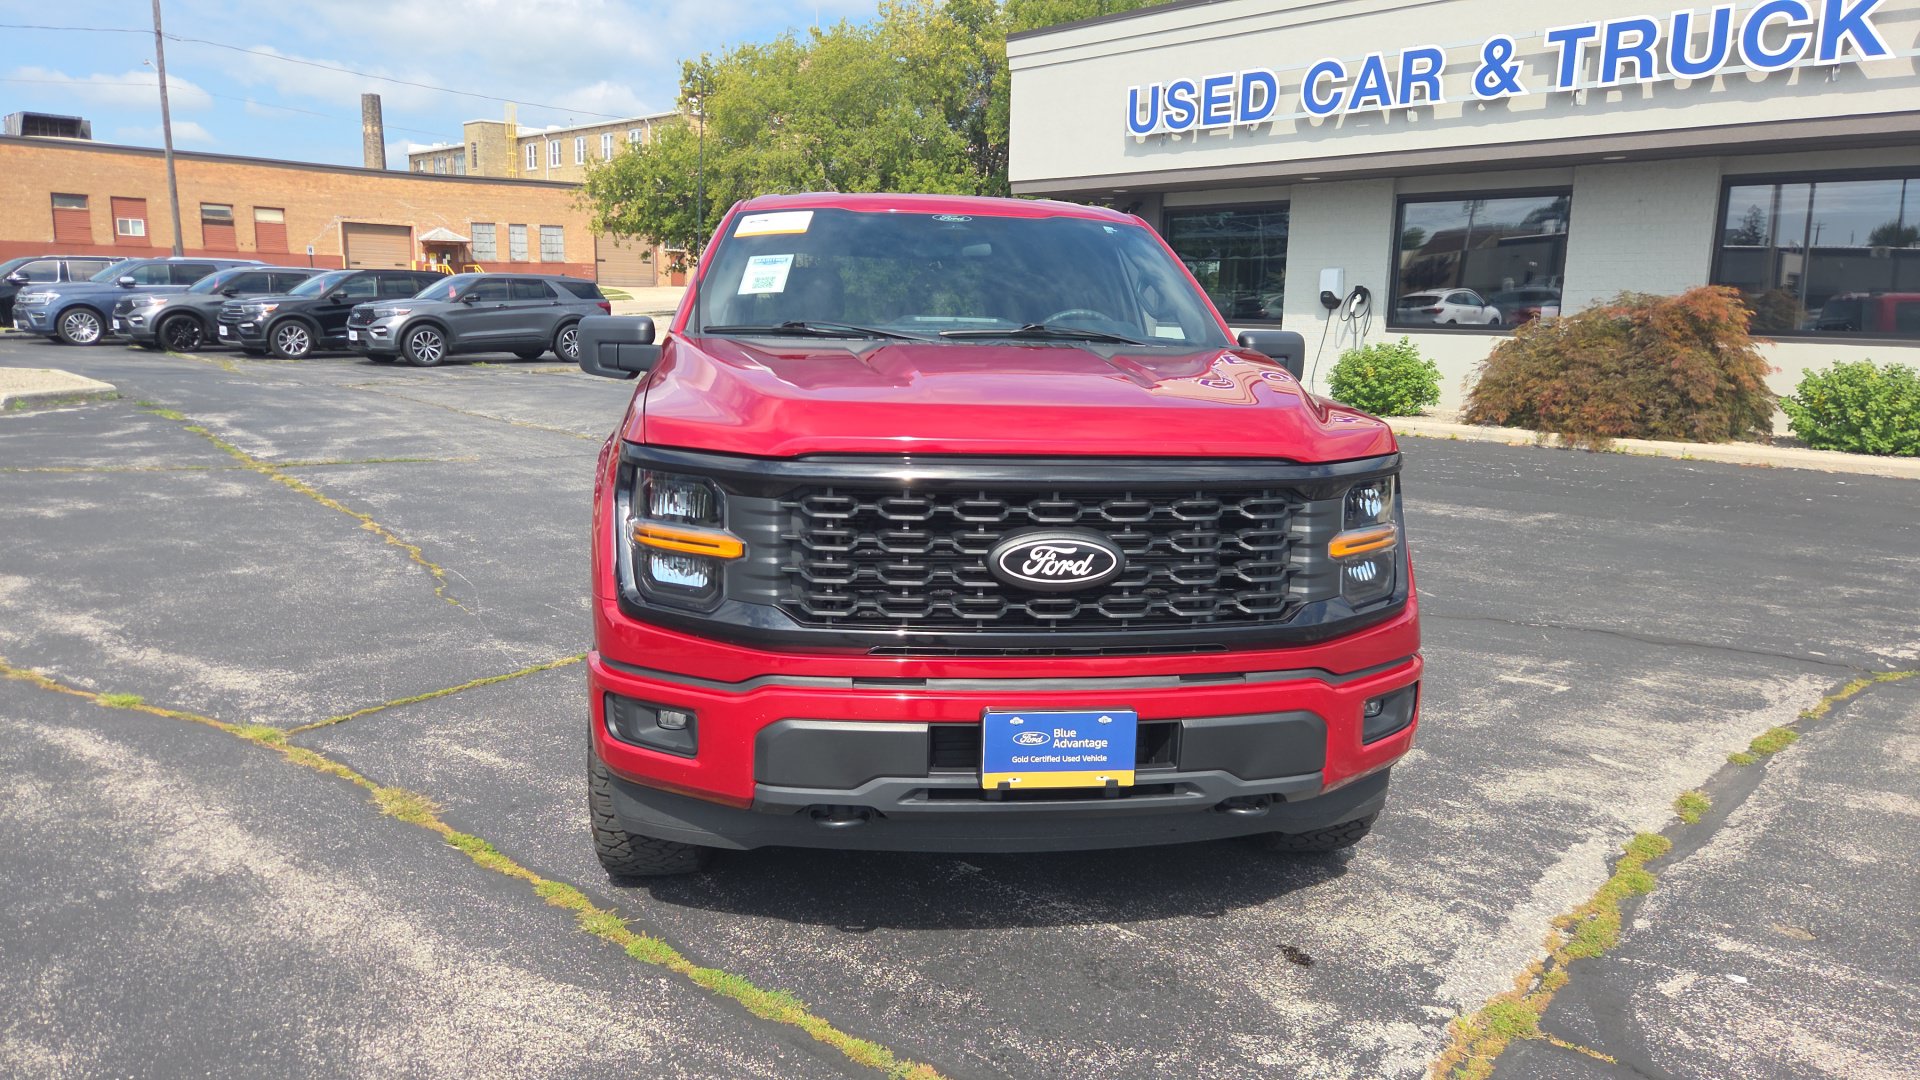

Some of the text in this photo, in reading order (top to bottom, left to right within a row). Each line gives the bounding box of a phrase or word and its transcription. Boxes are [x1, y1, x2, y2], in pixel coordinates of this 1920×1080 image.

[1126, 0, 1896, 136] USED CAR & TRUCK
[1022, 545, 1095, 576] Ford
[1053, 728, 1077, 737] Blue
[1020, 733, 1043, 743] Ford
[1053, 739, 1108, 749] Advantage
[1012, 755, 1029, 763] Gold
